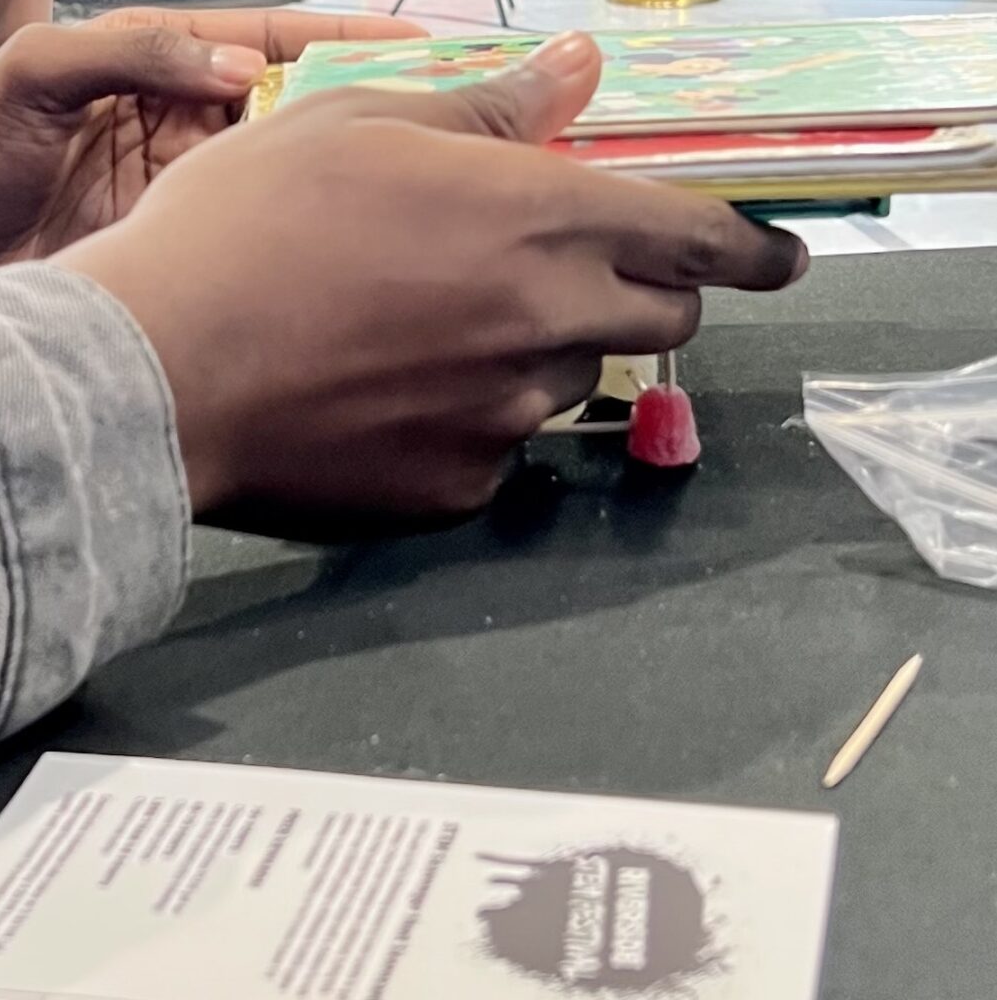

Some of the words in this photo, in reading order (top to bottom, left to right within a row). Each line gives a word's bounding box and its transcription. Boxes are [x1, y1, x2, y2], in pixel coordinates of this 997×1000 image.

[569, 855, 609, 898] STEM
[609, 865, 651, 971] RIVERSIDE
[558, 898, 606, 983] FESTIVAL
